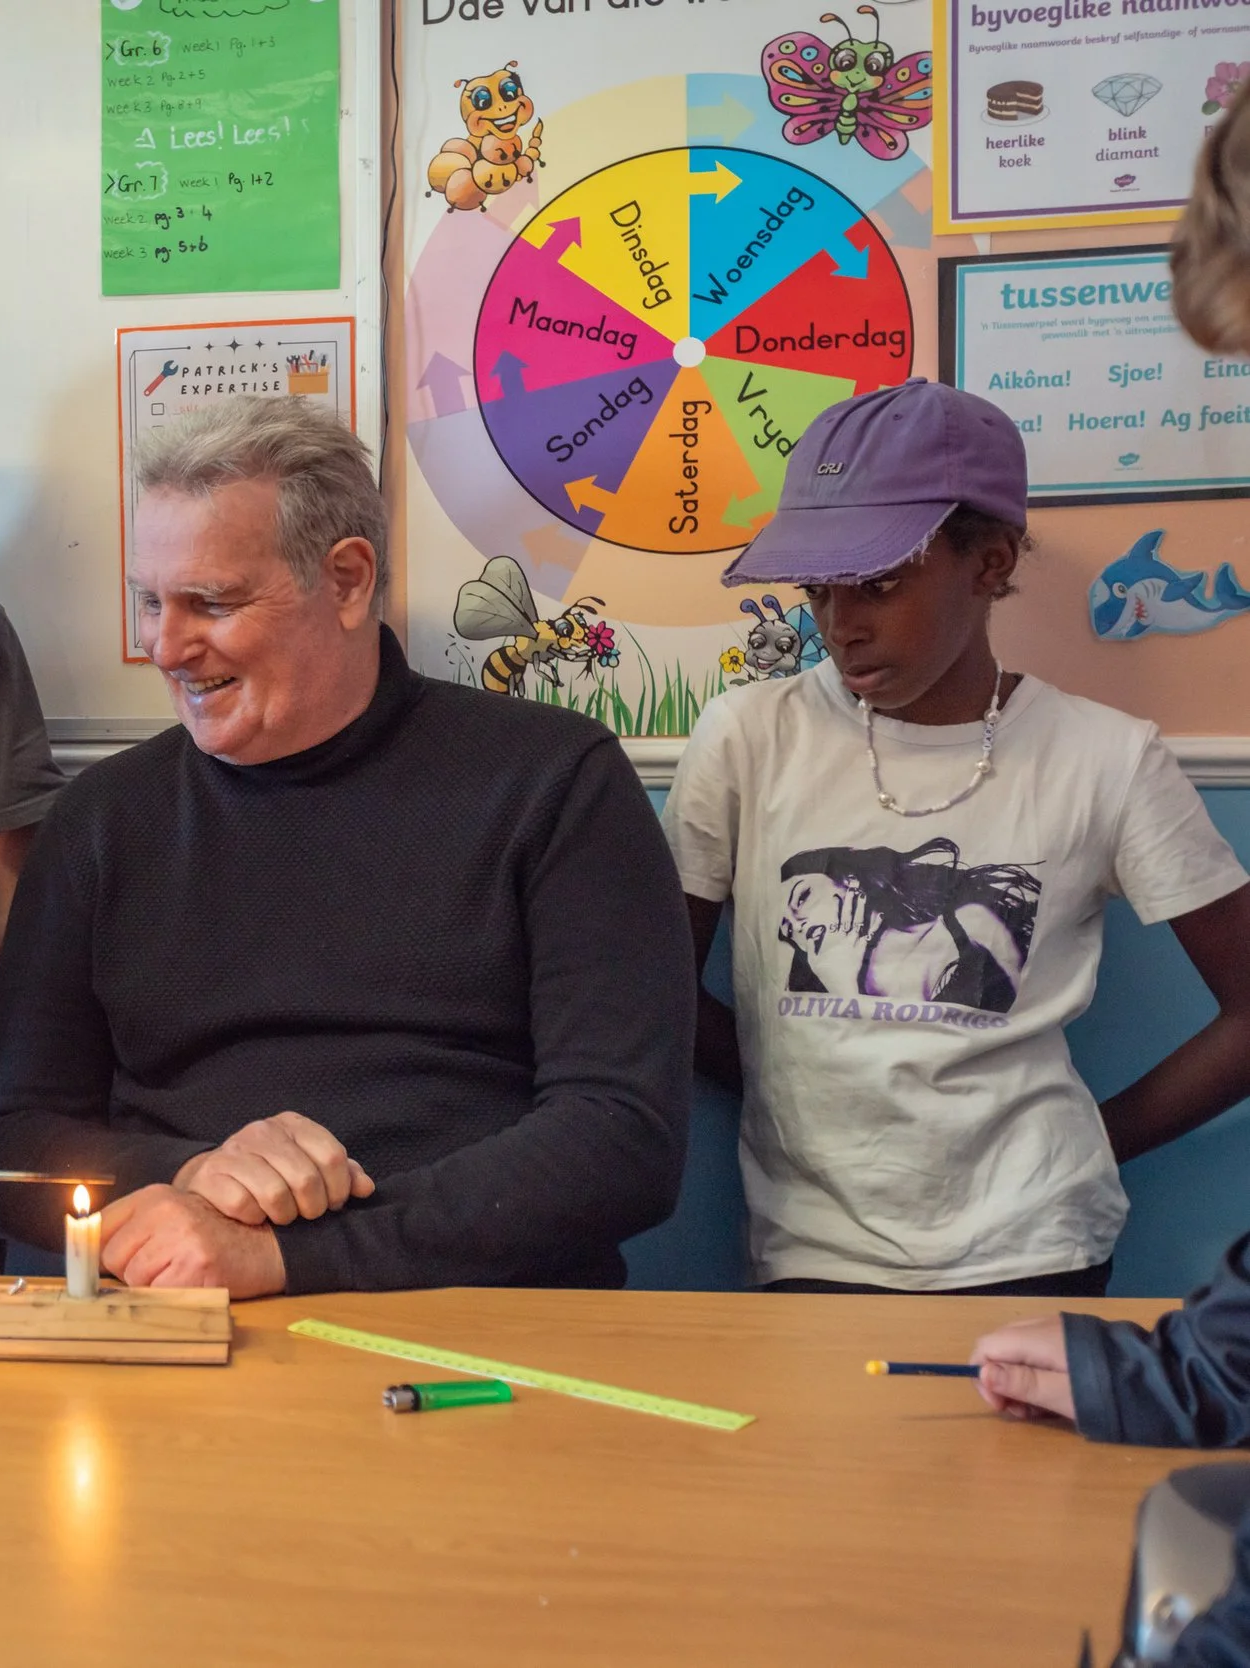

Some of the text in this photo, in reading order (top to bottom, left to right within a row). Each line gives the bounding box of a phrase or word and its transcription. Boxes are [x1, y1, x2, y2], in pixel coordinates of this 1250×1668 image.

[971, 0, 1111, 32] byvoeglike
[153, 40, 162, 56] 6
[968, 43, 1018, 54] Byvoeglike
[1021, 36, 1082, 50] naamwoorde
[1085, 33, 1121, 45] beskryf
[1187, 26, 1199, 38] of
[170, 115, 291, 150] Lees! Lees!
[985, 135, 1045, 150] heerlike
[1108, 126, 1147, 141] blink
[998, 154, 1032, 168] koek
[1095, 146, 1159, 162] diamant
[149, 175, 157, 190] 7
[609, 200, 672, 310] Dinsdag
[693, 185, 815, 307] Woensdag
[509, 297, 638, 361] Maandag
[735, 321, 906, 358] Donderdag
[181, 362, 280, 378] PATRICK'S
[989, 370, 1071, 391] Aikôna!
[1108, 362, 1163, 387] Sjoe!
[180, 380, 281, 395] EXPERTISE
[546, 376, 654, 463] Sondag
[1068, 410, 1146, 432] Hoera!
[1160, 408, 1191, 432] Ag
[668, 399, 712, 534] Saterdag
[817, 462, 843, 475] CRJ
[778, 996, 1010, 1029] OLIVIA RODRIGO
